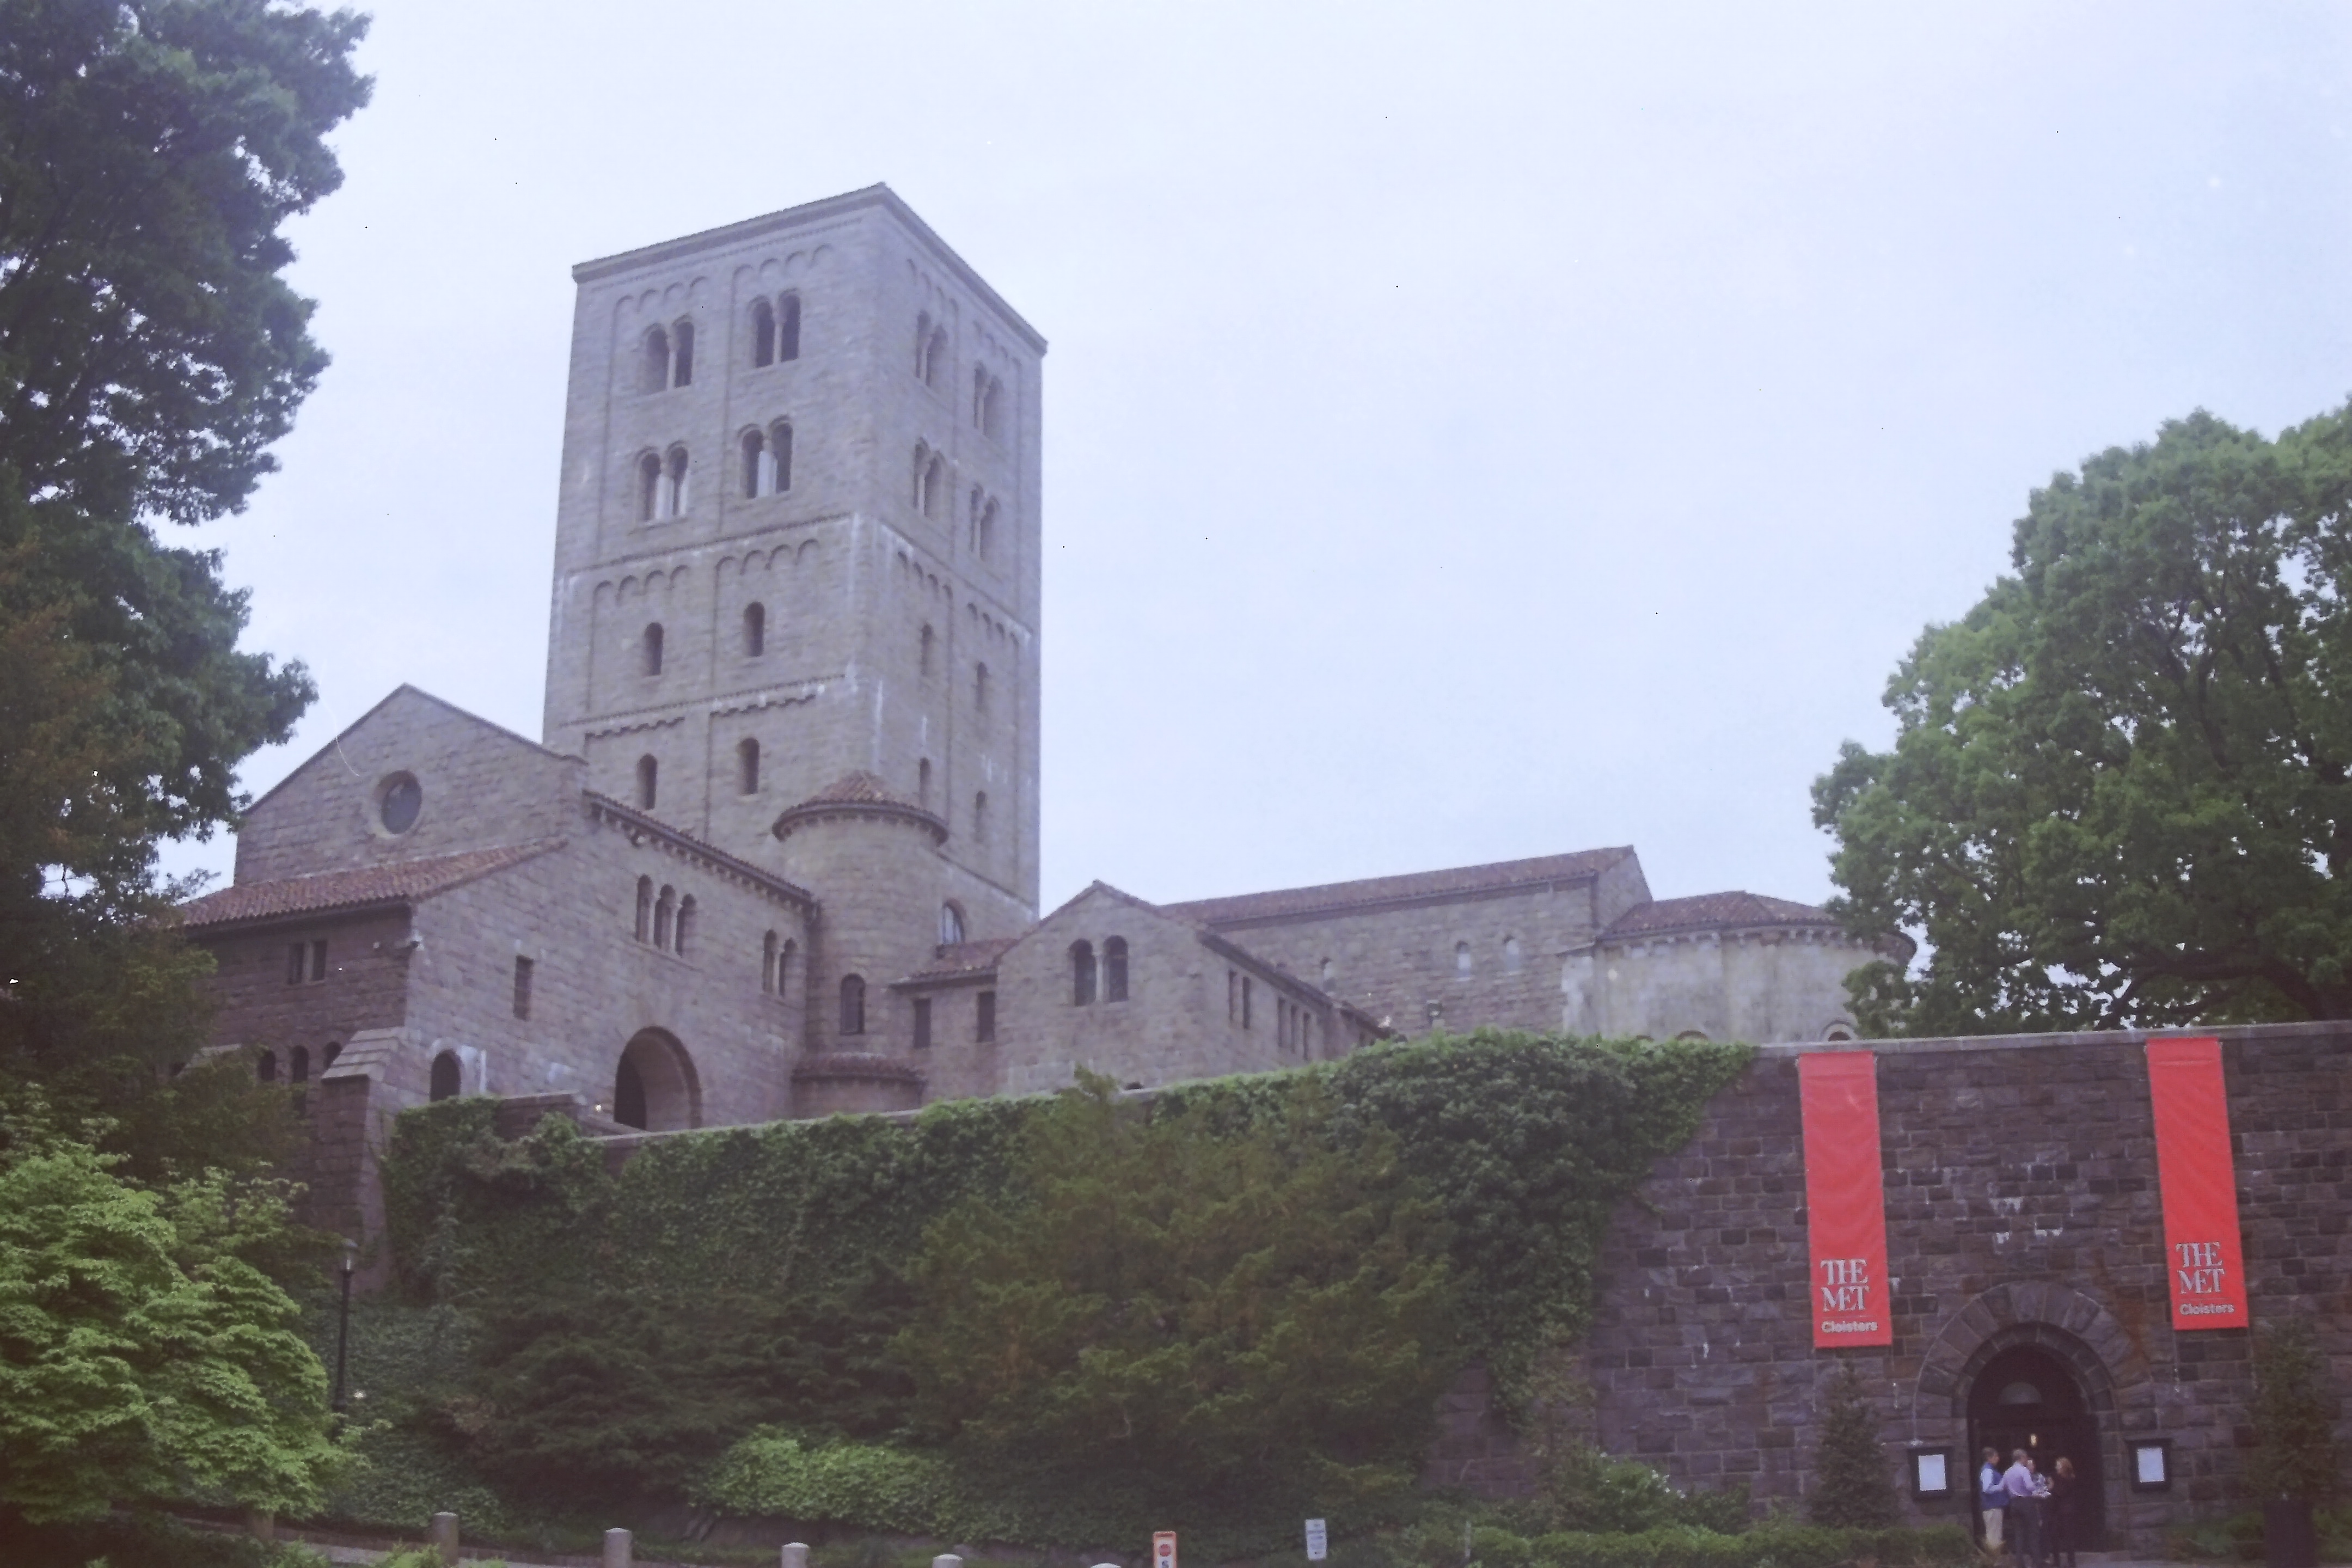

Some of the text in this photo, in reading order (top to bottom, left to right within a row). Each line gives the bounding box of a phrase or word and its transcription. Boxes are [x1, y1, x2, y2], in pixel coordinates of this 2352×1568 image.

[2176, 1242, 2222, 1267] THE
[1821, 1259, 1868, 1285] THE
[2177, 1269, 2225, 1293] MET
[1821, 1287, 1870, 1312] MET
[2179, 1303, 2234, 1315] Cloisters
[1821, 1320, 1877, 1333] Cloisters
